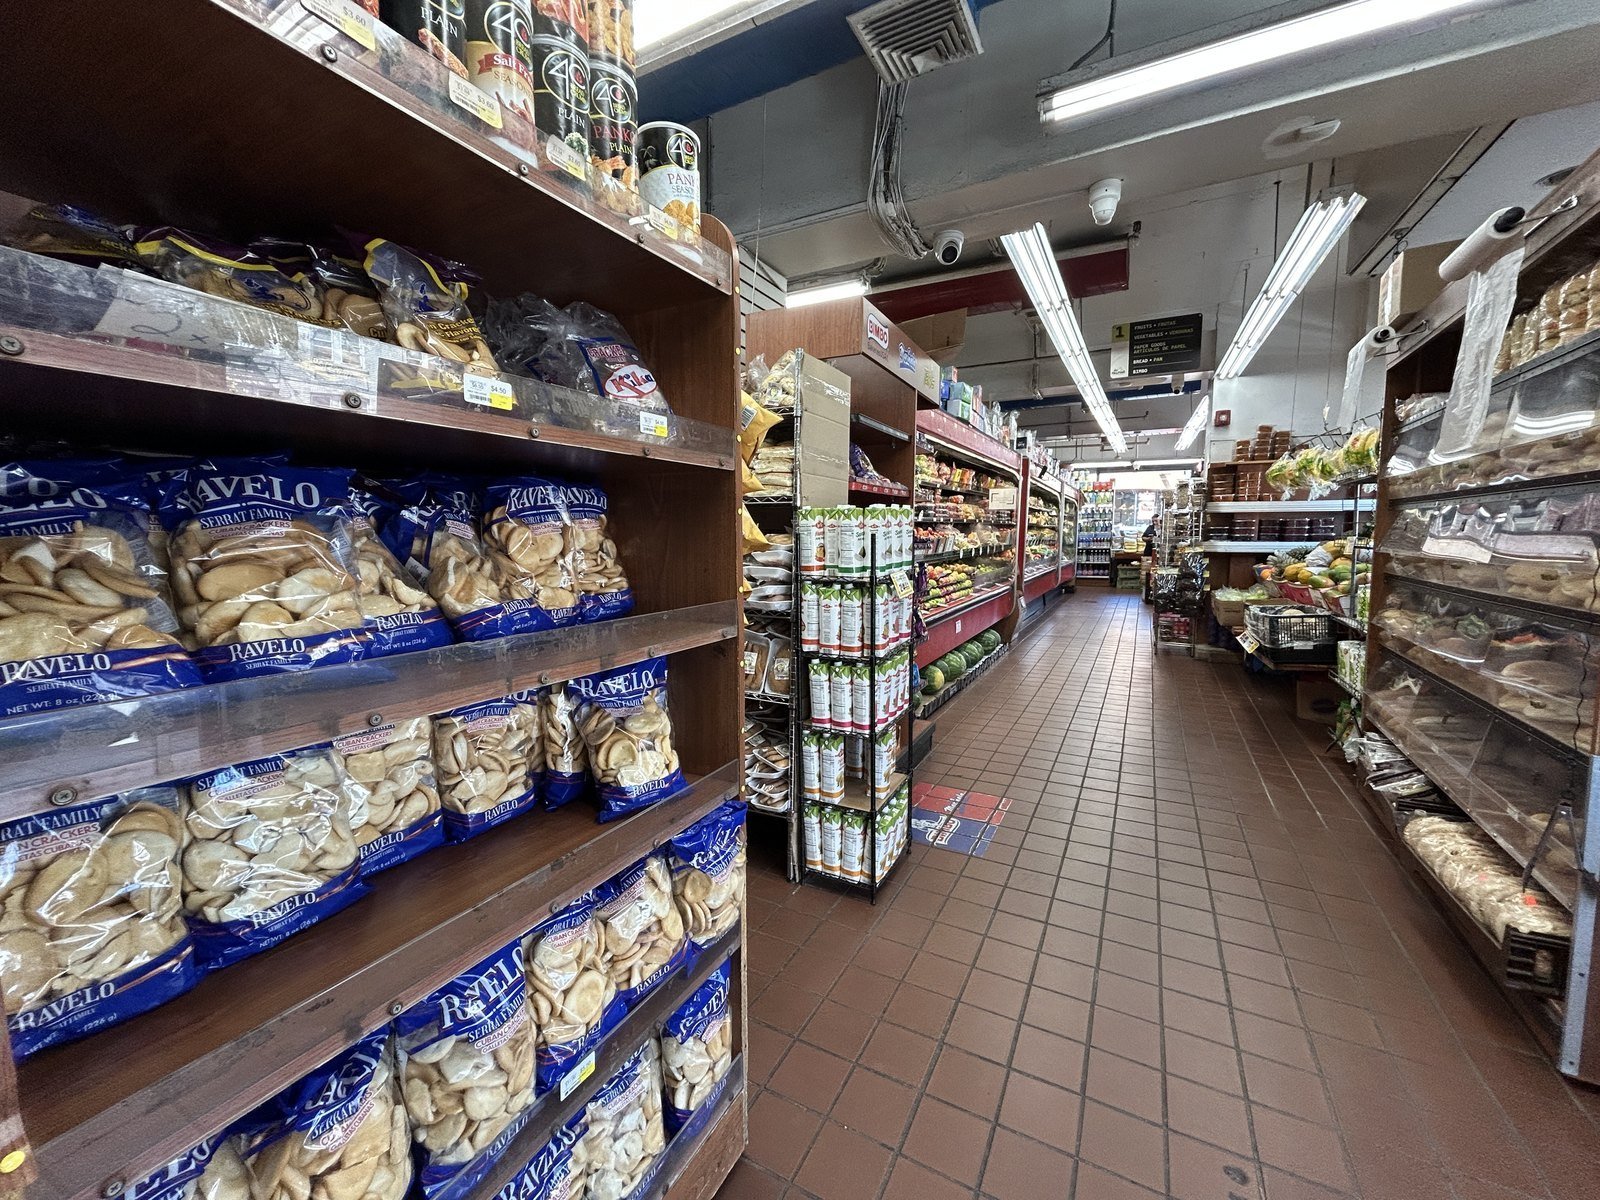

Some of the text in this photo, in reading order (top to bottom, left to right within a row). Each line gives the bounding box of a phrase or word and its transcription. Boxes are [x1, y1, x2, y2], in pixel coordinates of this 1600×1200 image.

[421, 7, 458, 38] PLAIN
[493, 54, 516, 69] Salt
[558, 107, 585, 128] PLAIN
[670, 138, 694, 167] 4C
[667, 173, 694, 187] PAN
[672, 185, 694, 195] SEASO
[438, 317, 475, 330] Cracke
[868, 319, 888, 344] BIMBO
[1115, 326, 1125, 338] 1
[1134, 331, 1163, 340] VEGETABLES
[491, 385, 507, 394] $4.50
[200, 508, 293, 529] SERRAT FAMILY
[10, 521, 74, 536] FAMILY
[503, 599, 531, 615] RAVELO
[375, 613, 423, 631] RAVELO
[228, 638, 305, 662] RAVELO
[1, 653, 112, 685] RAVELO
[7, 704, 28, 715] NET
[338, 730, 392, 748] CUBAN CRACKERS
[248, 760, 284, 775] FAMILY
[633, 780, 665, 798] RAVELO
[484, 800, 518, 823] RAVELO
[0, 806, 101, 841] RAT FAMILY
[31, 823, 99, 848] CRACKERS
[360, 831, 404, 860] RAVELO
[252, 892, 316, 930] RAVELO
[546, 932, 568, 944] CUBAN
[635, 964, 670, 995] RAVELO
[18, 982, 115, 1032] RAVELO
[468, 1015, 500, 1042] SERRAT
[475, 1031, 503, 1049] CUBAN
[312, 1102, 353, 1139] SERRAT
